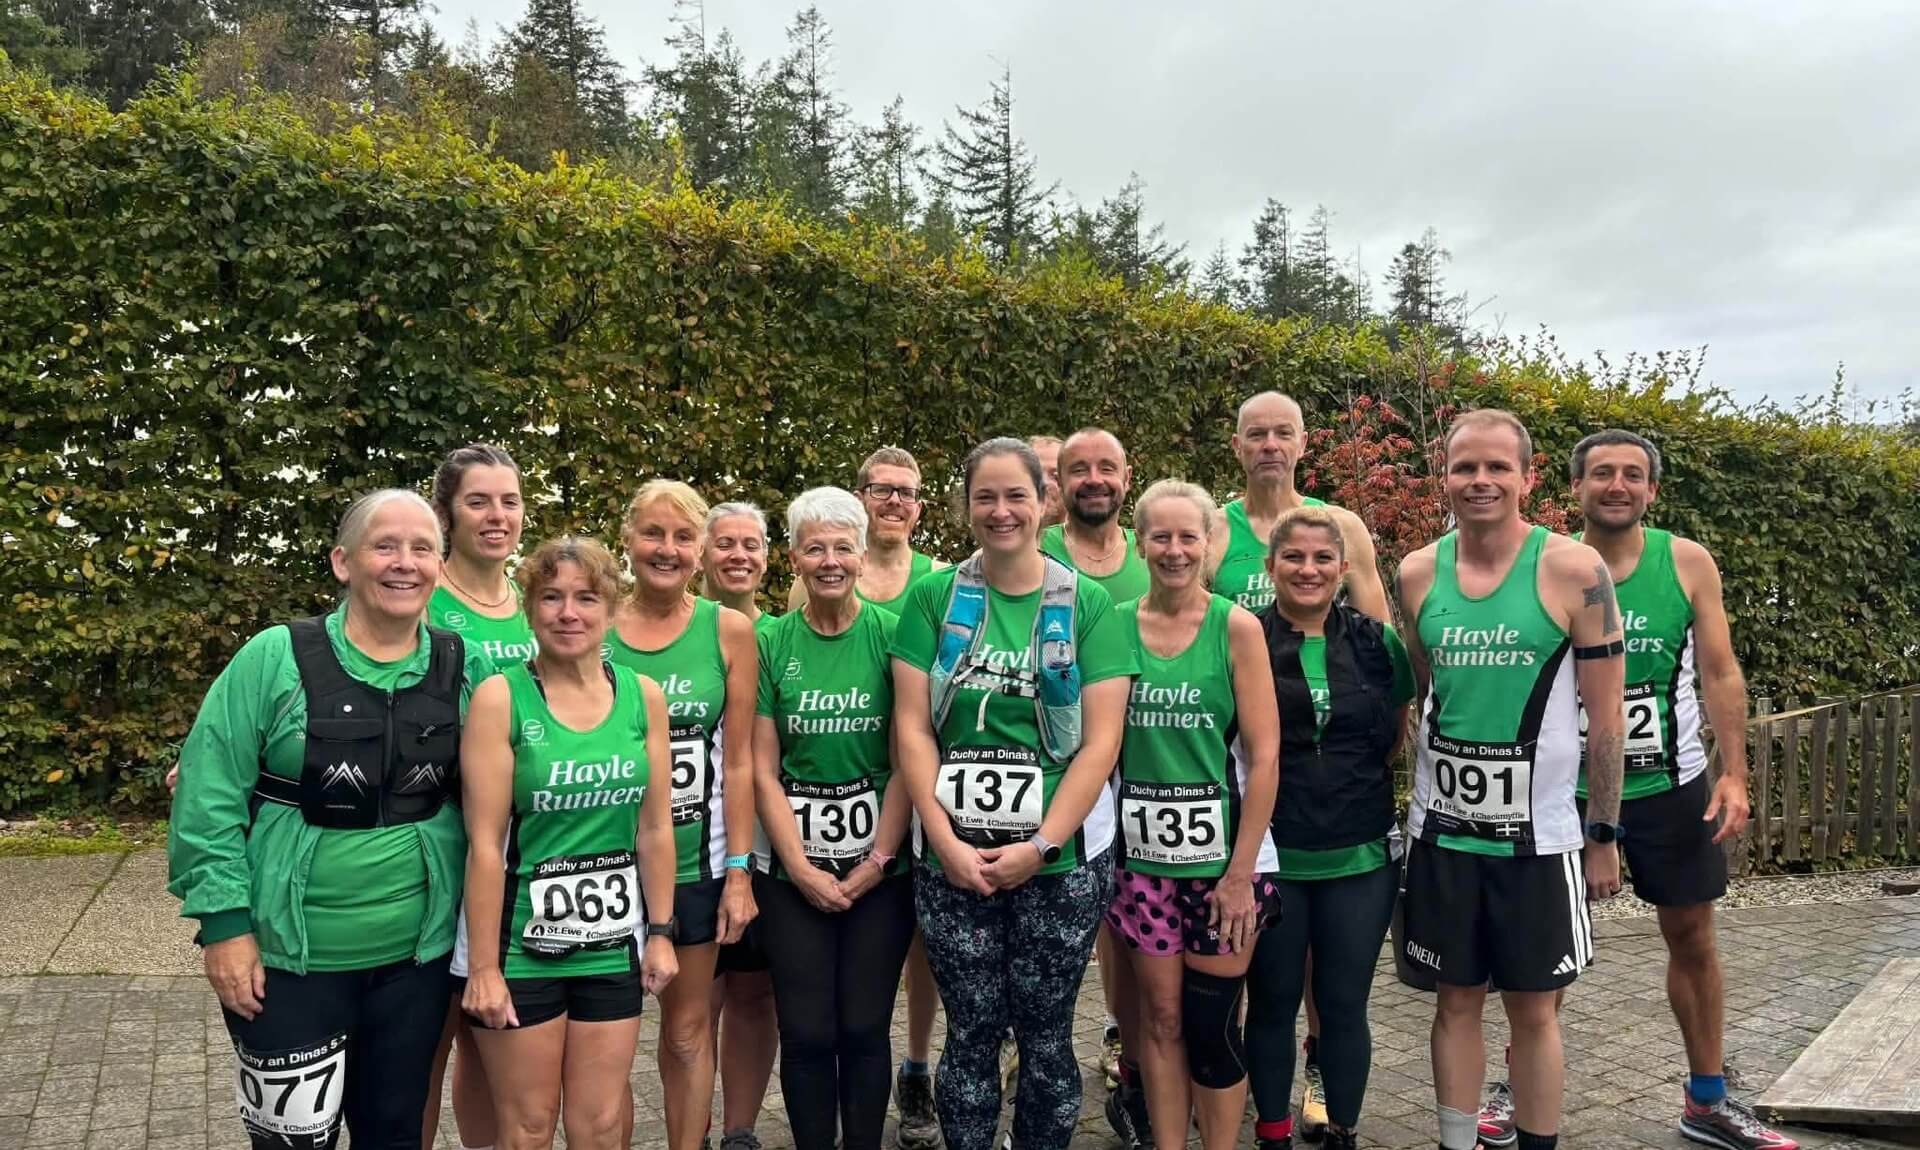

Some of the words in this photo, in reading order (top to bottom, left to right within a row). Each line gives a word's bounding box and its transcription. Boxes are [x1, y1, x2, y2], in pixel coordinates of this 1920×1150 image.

[482, 638, 540, 663] Hayl
[1440, 623, 1520, 651] Hayle
[1432, 647, 1537, 667] Runners
[797, 687, 872, 716] Hayle
[1130, 682, 1202, 710] Hayle
[1624, 687, 1644, 697] inas
[1644, 684, 1651, 694] 5
[787, 713, 884, 735] Runners
[949, 749, 980, 761] Duchy
[981, 750, 995, 759] an
[997, 749, 1029, 761] Dinas
[1433, 737, 1461, 754] Duchy
[1463, 744, 1477, 756] an
[1479, 746, 1512, 756] Dinas
[1515, 746, 1524, 756] 5
[546, 754, 636, 789] Hayle
[1435, 758, 1513, 806] 091
[531, 783, 647, 813] Runners
[792, 783, 820, 796] Duchy
[822, 788, 834, 797] an
[836, 782, 862, 796] Dinas
[862, 779, 869, 788] 5
[947, 768, 1037, 814] 137
[1130, 784, 1157, 798] Duchy
[1158, 788, 1172, 797] an
[1174, 786, 1206, 797] Dinas
[1207, 785, 1215, 796] 5
[794, 799, 874, 844] 130
[1130, 806, 1216, 849] 135
[579, 859, 593, 869] an
[595, 853, 626, 868] Dinas
[543, 873, 631, 924] 063
[546, 924, 583, 937] St.Ewe
[1407, 940, 1441, 970] ONEILL
[268, 1057, 285, 1066] an
[289, 1045, 328, 1063] Dinas
[330, 1038, 338, 1050] 5
[240, 1061, 338, 1117] 077
